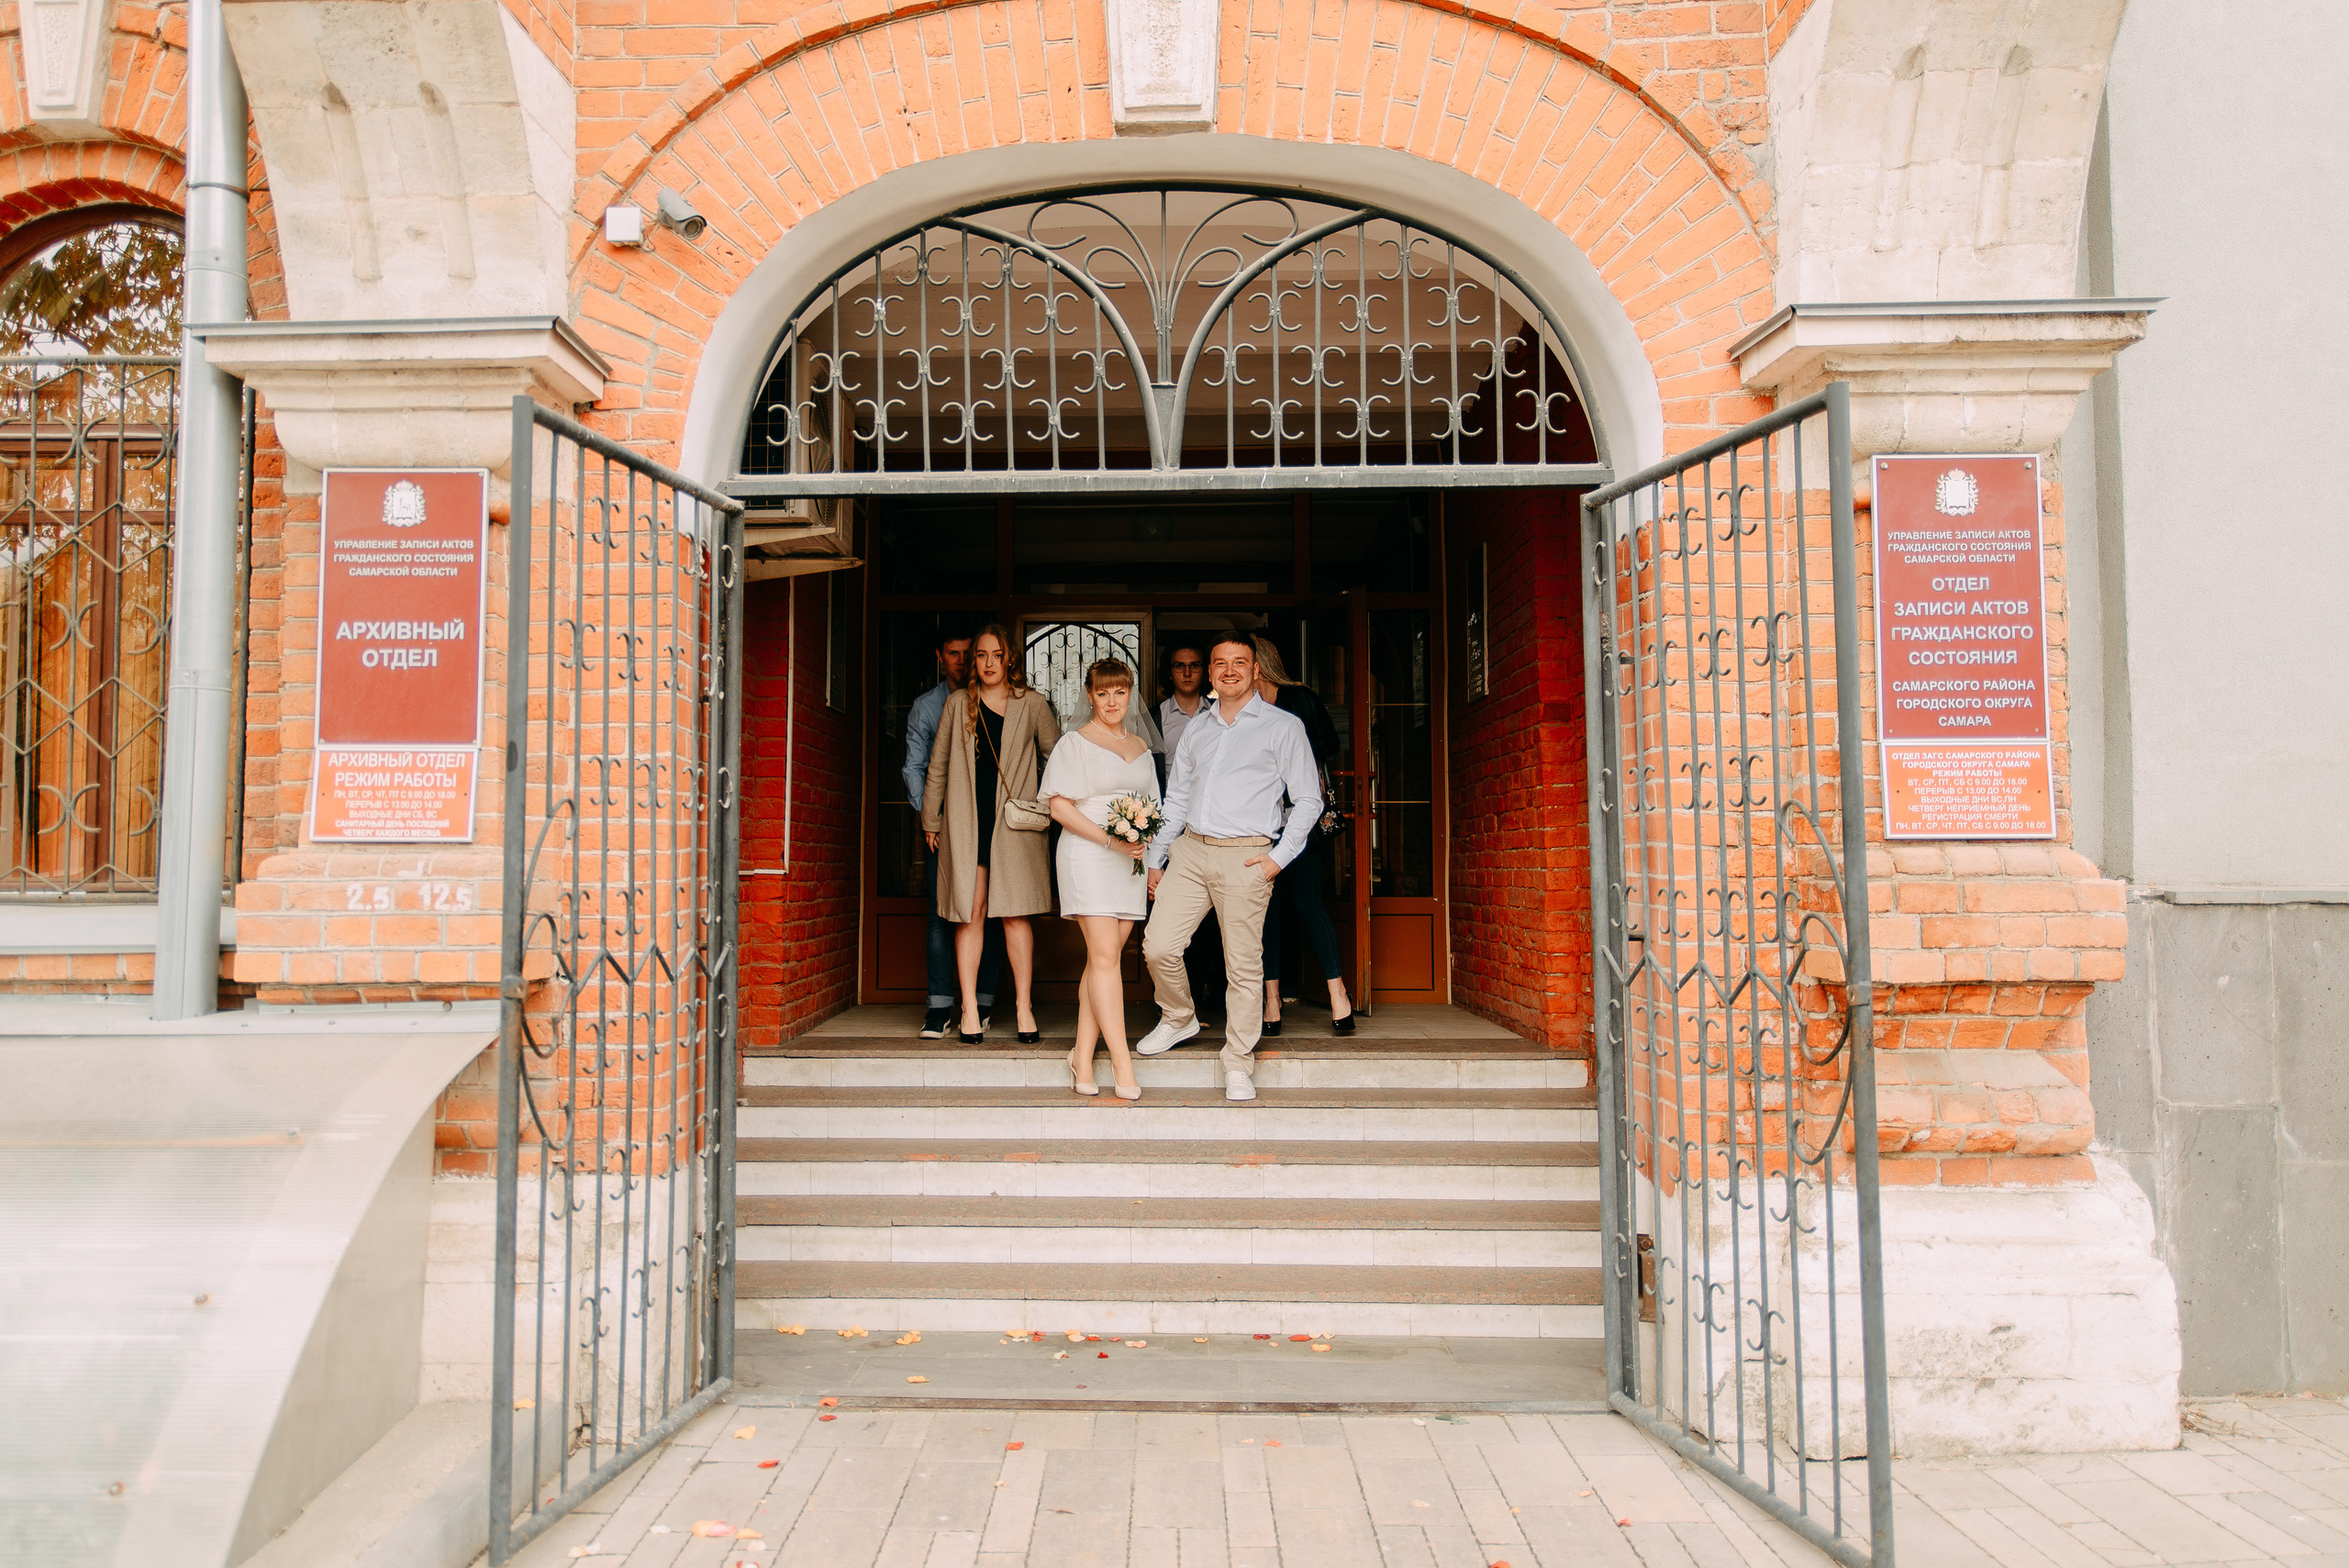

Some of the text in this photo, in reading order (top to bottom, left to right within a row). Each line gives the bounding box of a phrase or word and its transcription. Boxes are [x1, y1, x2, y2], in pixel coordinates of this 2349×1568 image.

[1887, 531, 1953, 539] УПРАВЛЕНИЕ
[1955, 531, 1995, 539] ЗАПИСИ
[334, 540, 473, 549] УПРАВЛЕНИЕ ЗАПИСИ АКТОВ
[1887, 542, 2032, 552] ГРАЖДАНСКОГО СОСТОЯНИЯ
[334, 554, 473, 563] ГРАЖДАНСКОГО СОСТОЯНИЯ
[1904, 553, 2015, 563] САМАРСКОЙ ОБЛАСТИ
[349, 567, 458, 576] САМАРСКОЙ ОБЛАСТИ
[1932, 577, 1989, 593] ОТДЕЛ
[1894, 602, 2029, 616] ЗАПИСИ АКТОВ
[336, 619, 464, 639] АРХИВНЫЙ
[1891, 626, 2033, 642] ГРАЖДАНСКОГО
[362, 649, 438, 670] ОТДЕЛ
[1909, 651, 2017, 665] СОСТОЯНИЯ
[1893, 678, 2035, 692] САМАРСКОГО РАЙОНА
[1897, 697, 2032, 710] ГОРОДСКОГО ОКРУГА
[1938, 717, 1991, 727] САМАРА
[328, 752, 413, 767] АРХИВНЫЙ
[1892, 752, 1920, 761] ОТДЕЛ
[1902, 761, 1959, 769] ГОРОДСКОГО
[394, 773, 456, 787] РАБОТЫ
[2002, 787, 2021, 796] 14.00
[2008, 804, 2031, 814] ДЕНЬ
[349, 811, 393, 820] ВЫХОДНЫЕ
[1922, 814, 2019, 823] РЕГИСТРАЦИЯ СМЕРТИ
[336, 819, 384, 828] САНИТАРНЫЙ
[406, 819, 450, 828] ПОСЛЕДНИЙ
[342, 829, 441, 839] ЧЕТВЕРГ КАЖДОГО МЕСЯЦА
